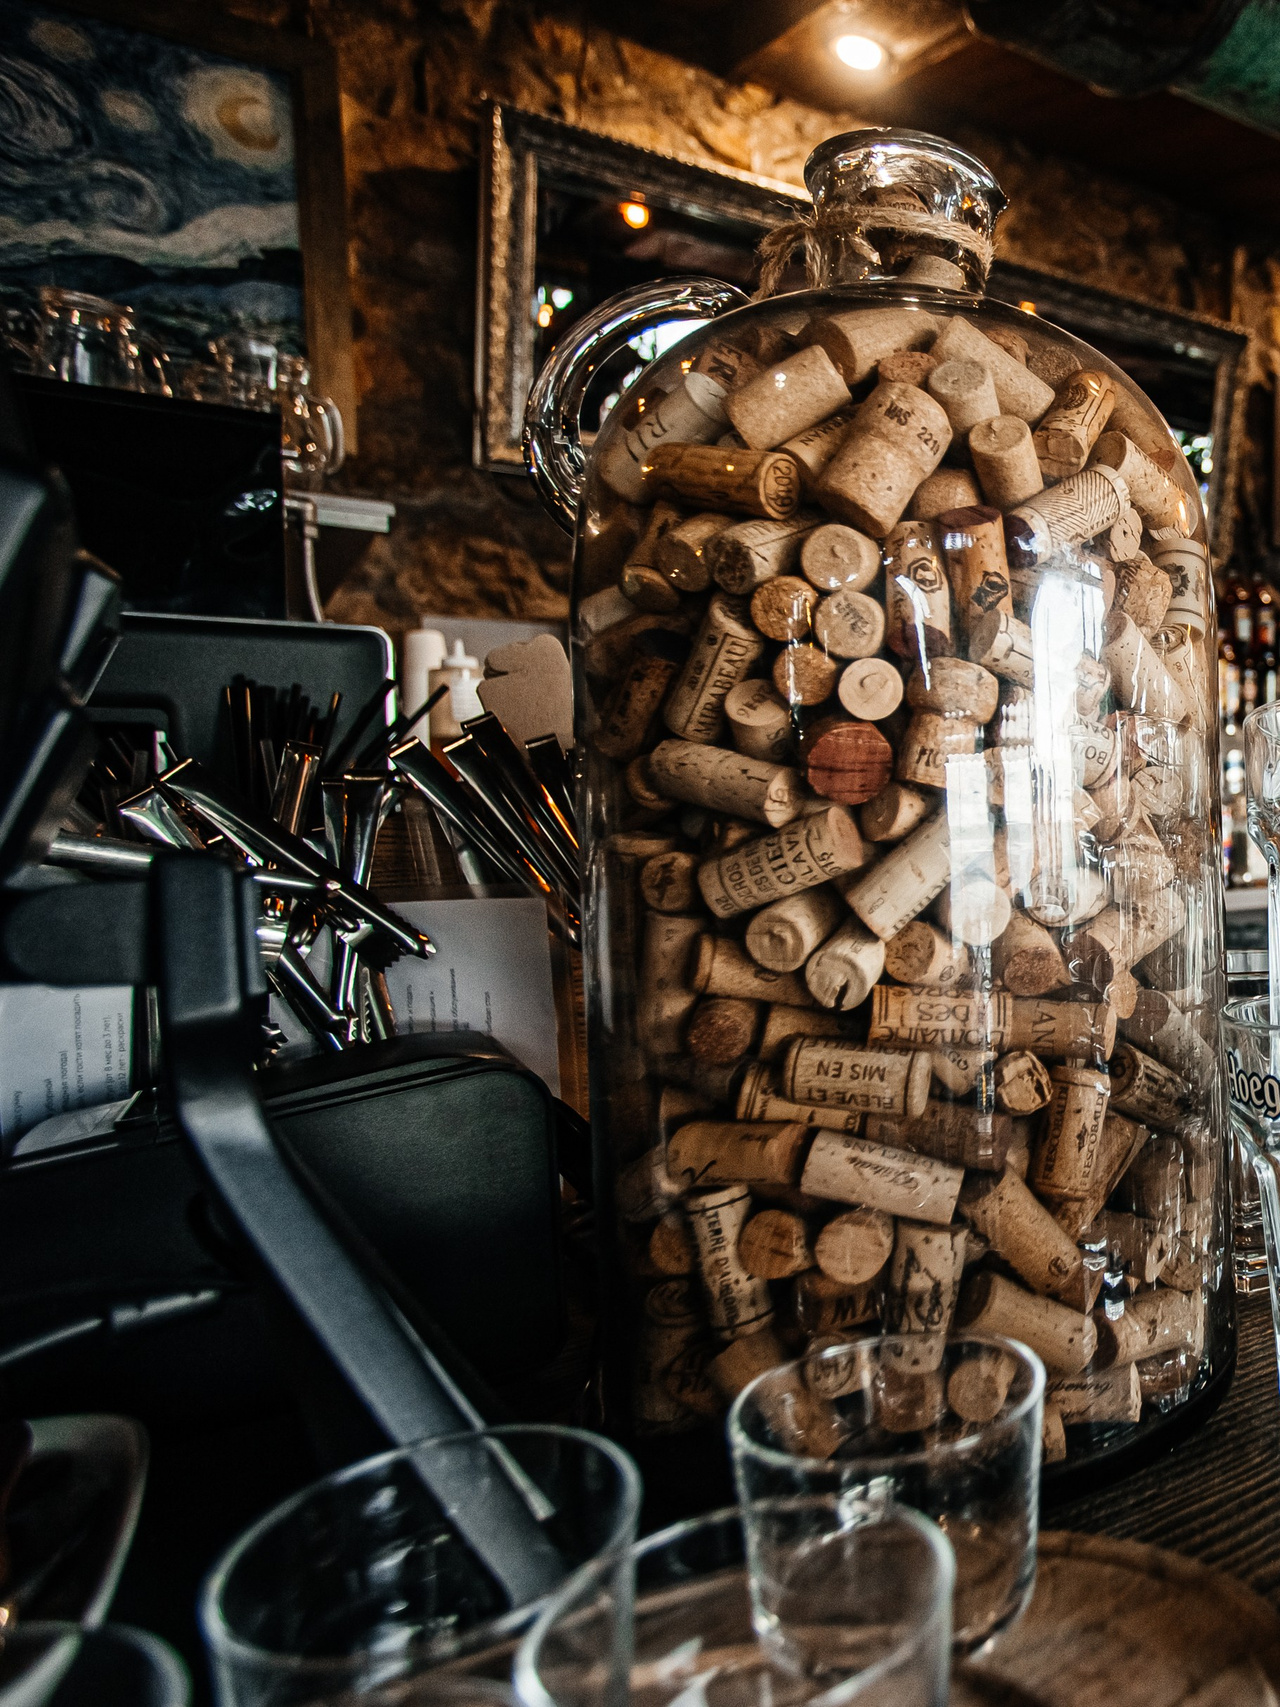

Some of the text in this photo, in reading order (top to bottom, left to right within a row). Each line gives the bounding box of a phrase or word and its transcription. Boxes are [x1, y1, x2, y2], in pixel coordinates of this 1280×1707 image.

[692, 639, 750, 737] MIRABEAU
[815, 1059, 887, 1083] MIS EN
